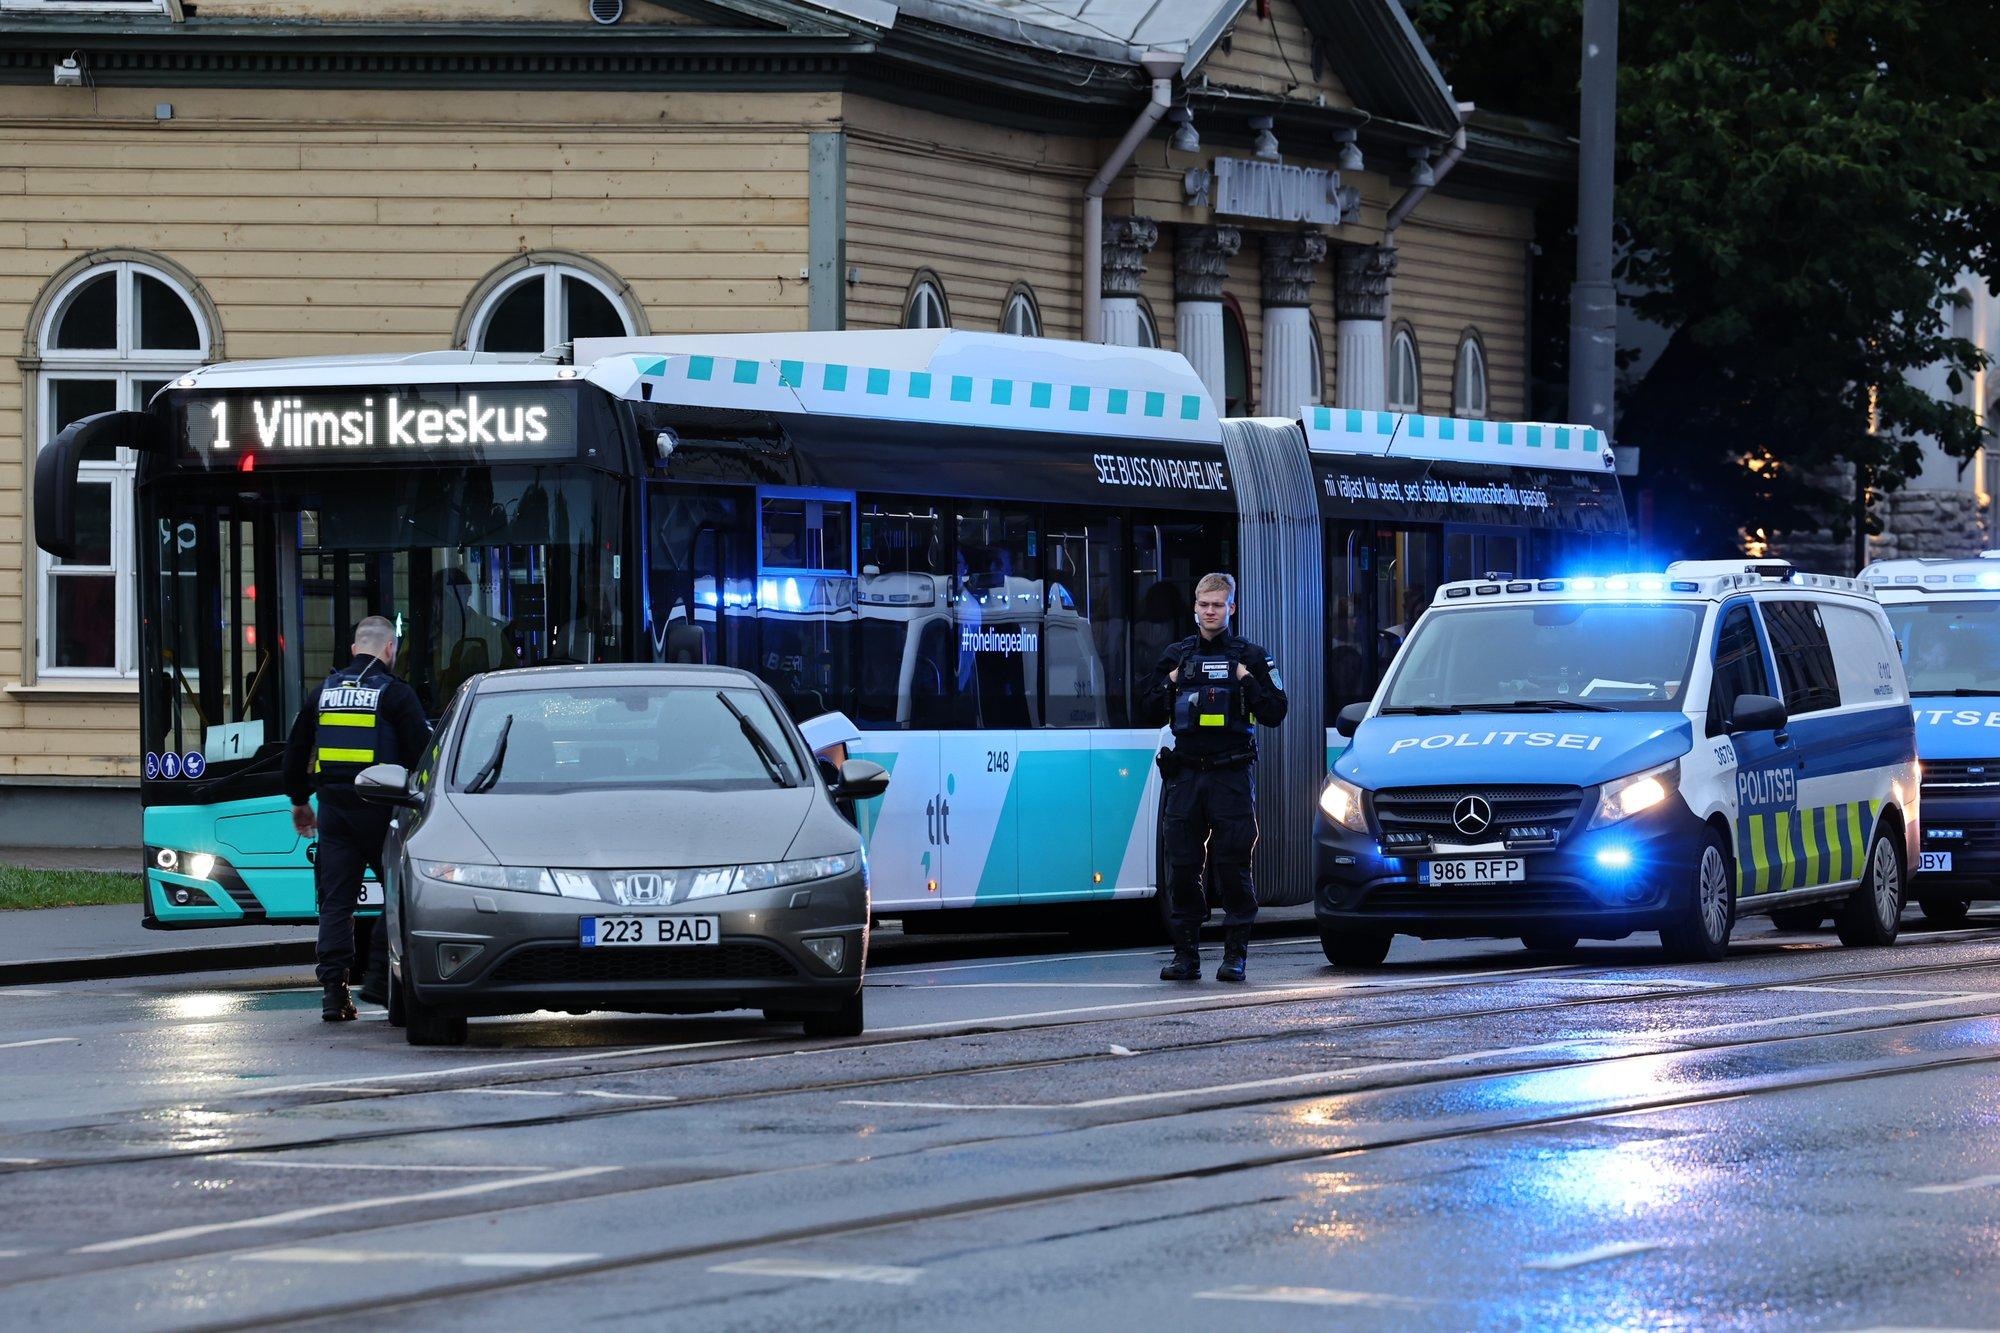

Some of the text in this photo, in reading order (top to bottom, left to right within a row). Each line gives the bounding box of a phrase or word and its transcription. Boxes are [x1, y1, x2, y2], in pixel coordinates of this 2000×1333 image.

[211, 395, 548, 449] 1 Viimsi keskus
[1093, 453, 1228, 491] SEE BUSS ON ROHELINE
[1336, 474, 1365, 503] väljast
[1363, 475, 1379, 499] kui
[1403, 481, 1422, 502] sest
[1421, 480, 1449, 503] sõidab
[962, 626, 1037, 658] #rohelinepealinn
[321, 689, 377, 708] POLITSEI
[231, 733, 239, 754] 1
[1388, 731, 1602, 754] POLITSEI
[987, 750, 1010, 773] 2148
[1714, 744, 1735, 767] 3679
[1738, 768, 1795, 806] POLITSEI
[1433, 862, 1467, 880] 986
[1475, 861, 1519, 879] RFP
[582, 919, 711, 943] EST 223 BAD
